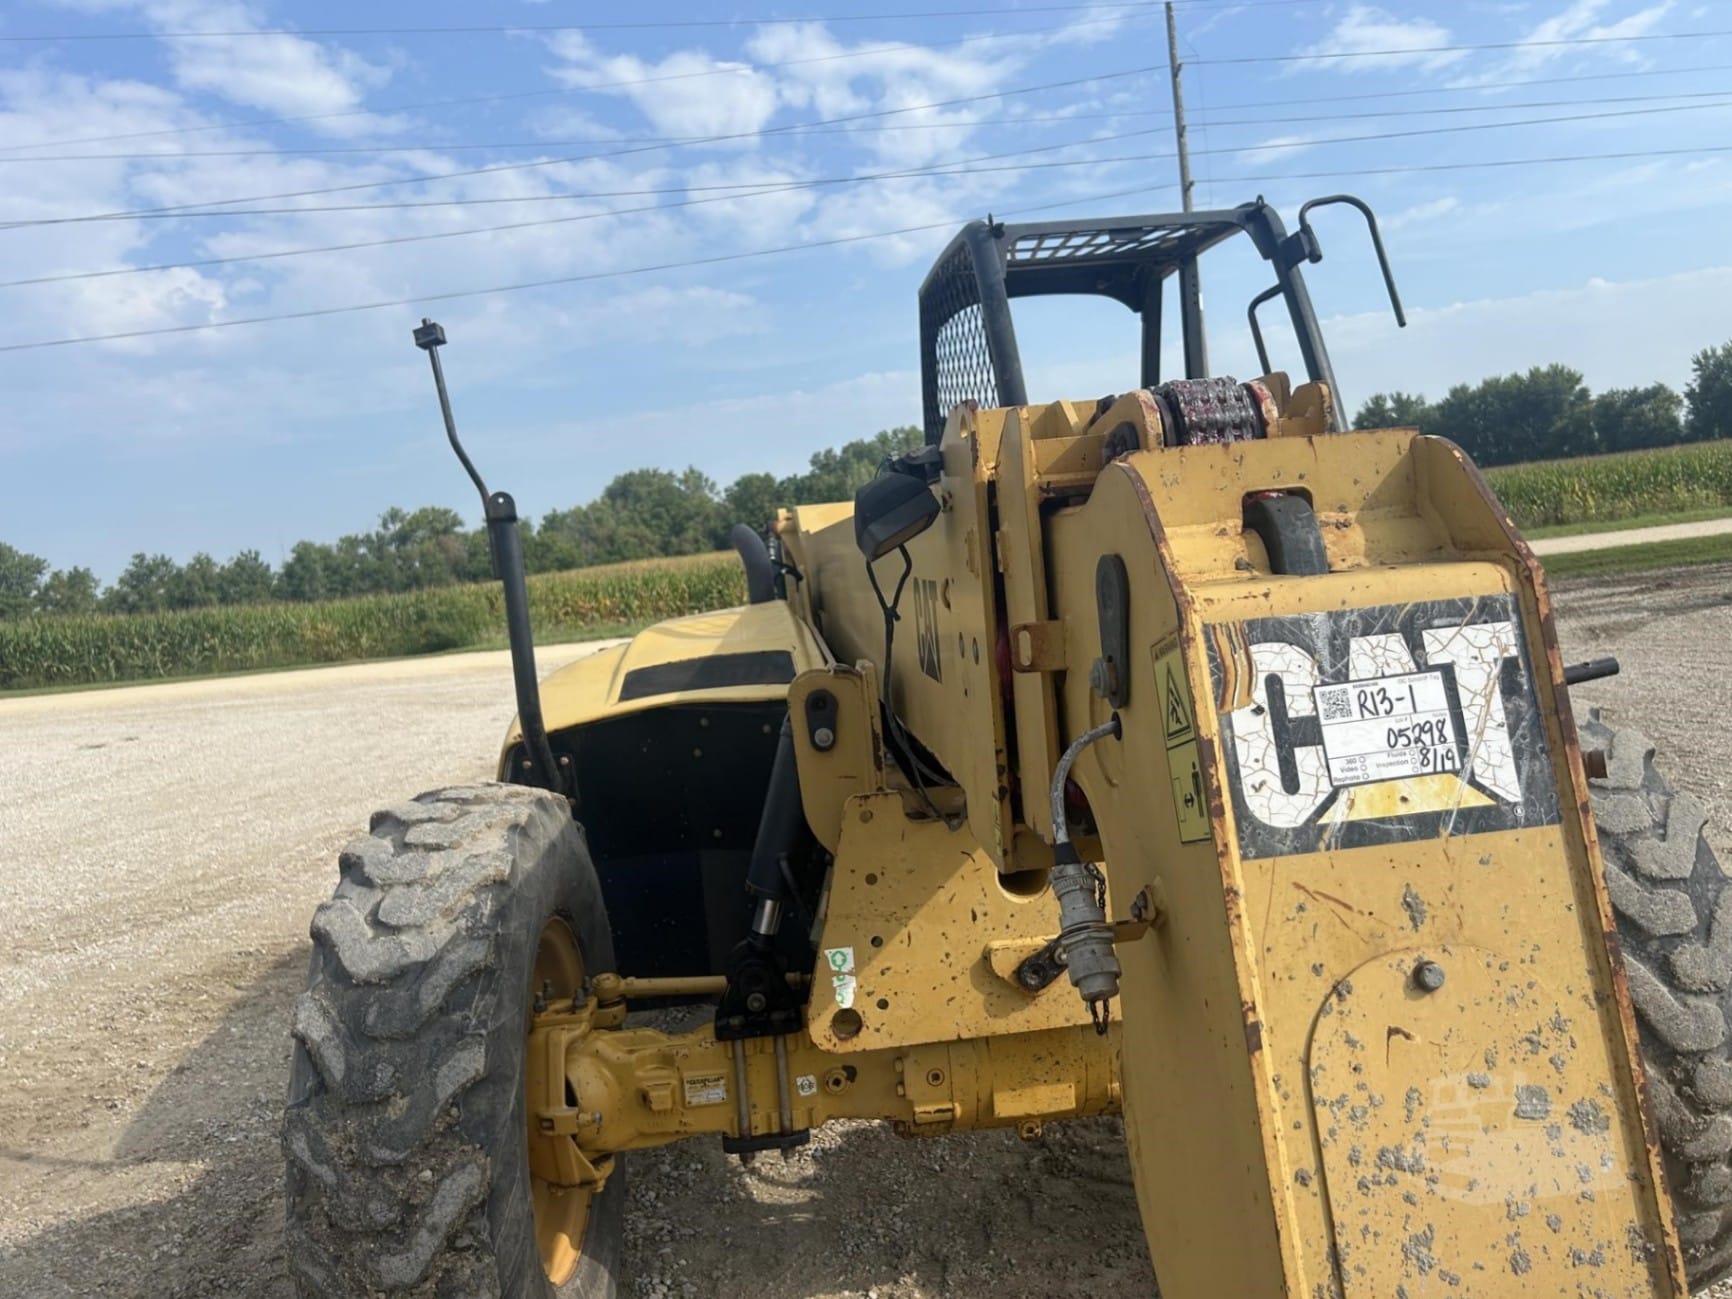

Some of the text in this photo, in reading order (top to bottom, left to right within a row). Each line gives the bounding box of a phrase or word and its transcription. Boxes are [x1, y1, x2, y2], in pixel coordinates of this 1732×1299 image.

[1357, 684, 1417, 719] R13-1
[1387, 718, 1448, 749] 05298
[1340, 765, 1359, 773] Video
[1376, 759, 1409, 768] Inspection
[1419, 747, 1456, 772] 8/19
